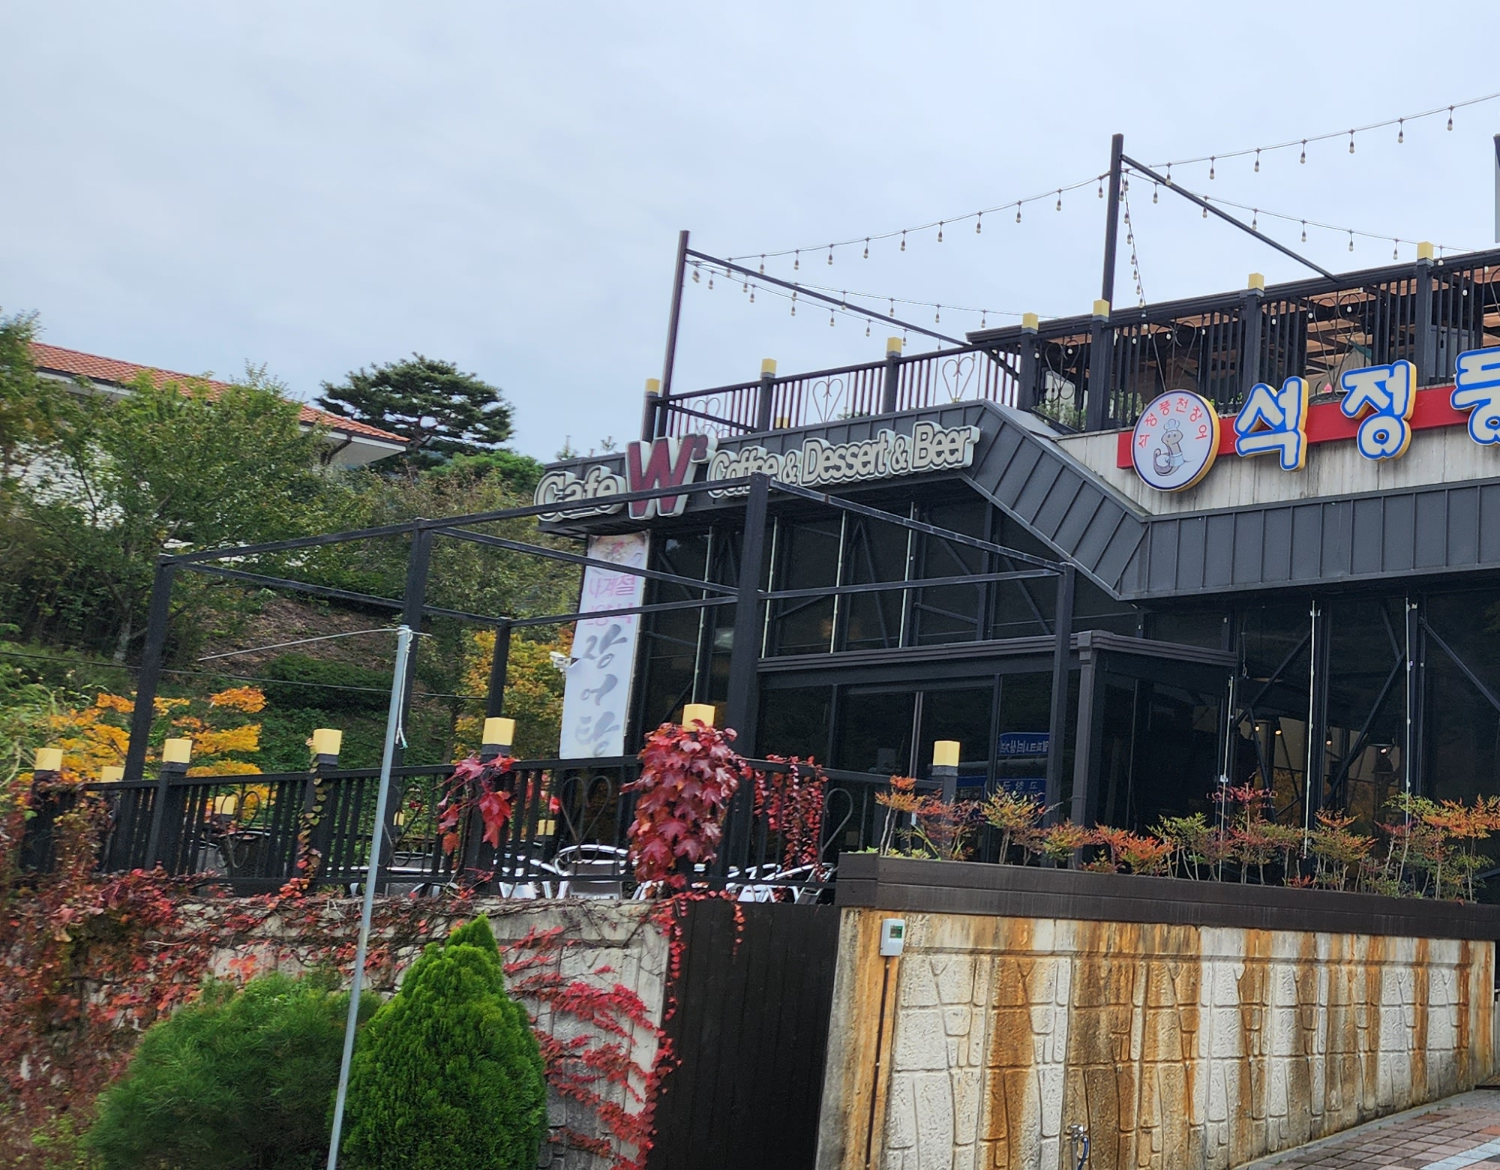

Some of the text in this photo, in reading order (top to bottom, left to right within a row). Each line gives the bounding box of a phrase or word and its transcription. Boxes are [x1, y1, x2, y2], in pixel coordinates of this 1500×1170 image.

[534, 466, 624, 521] Cafe
[707, 446, 781, 498] Coffee
[782, 450, 800, 486] &
[801, 430, 890, 486] Dessert
[891, 435, 910, 473] &
[912, 421, 976, 472] Beer
